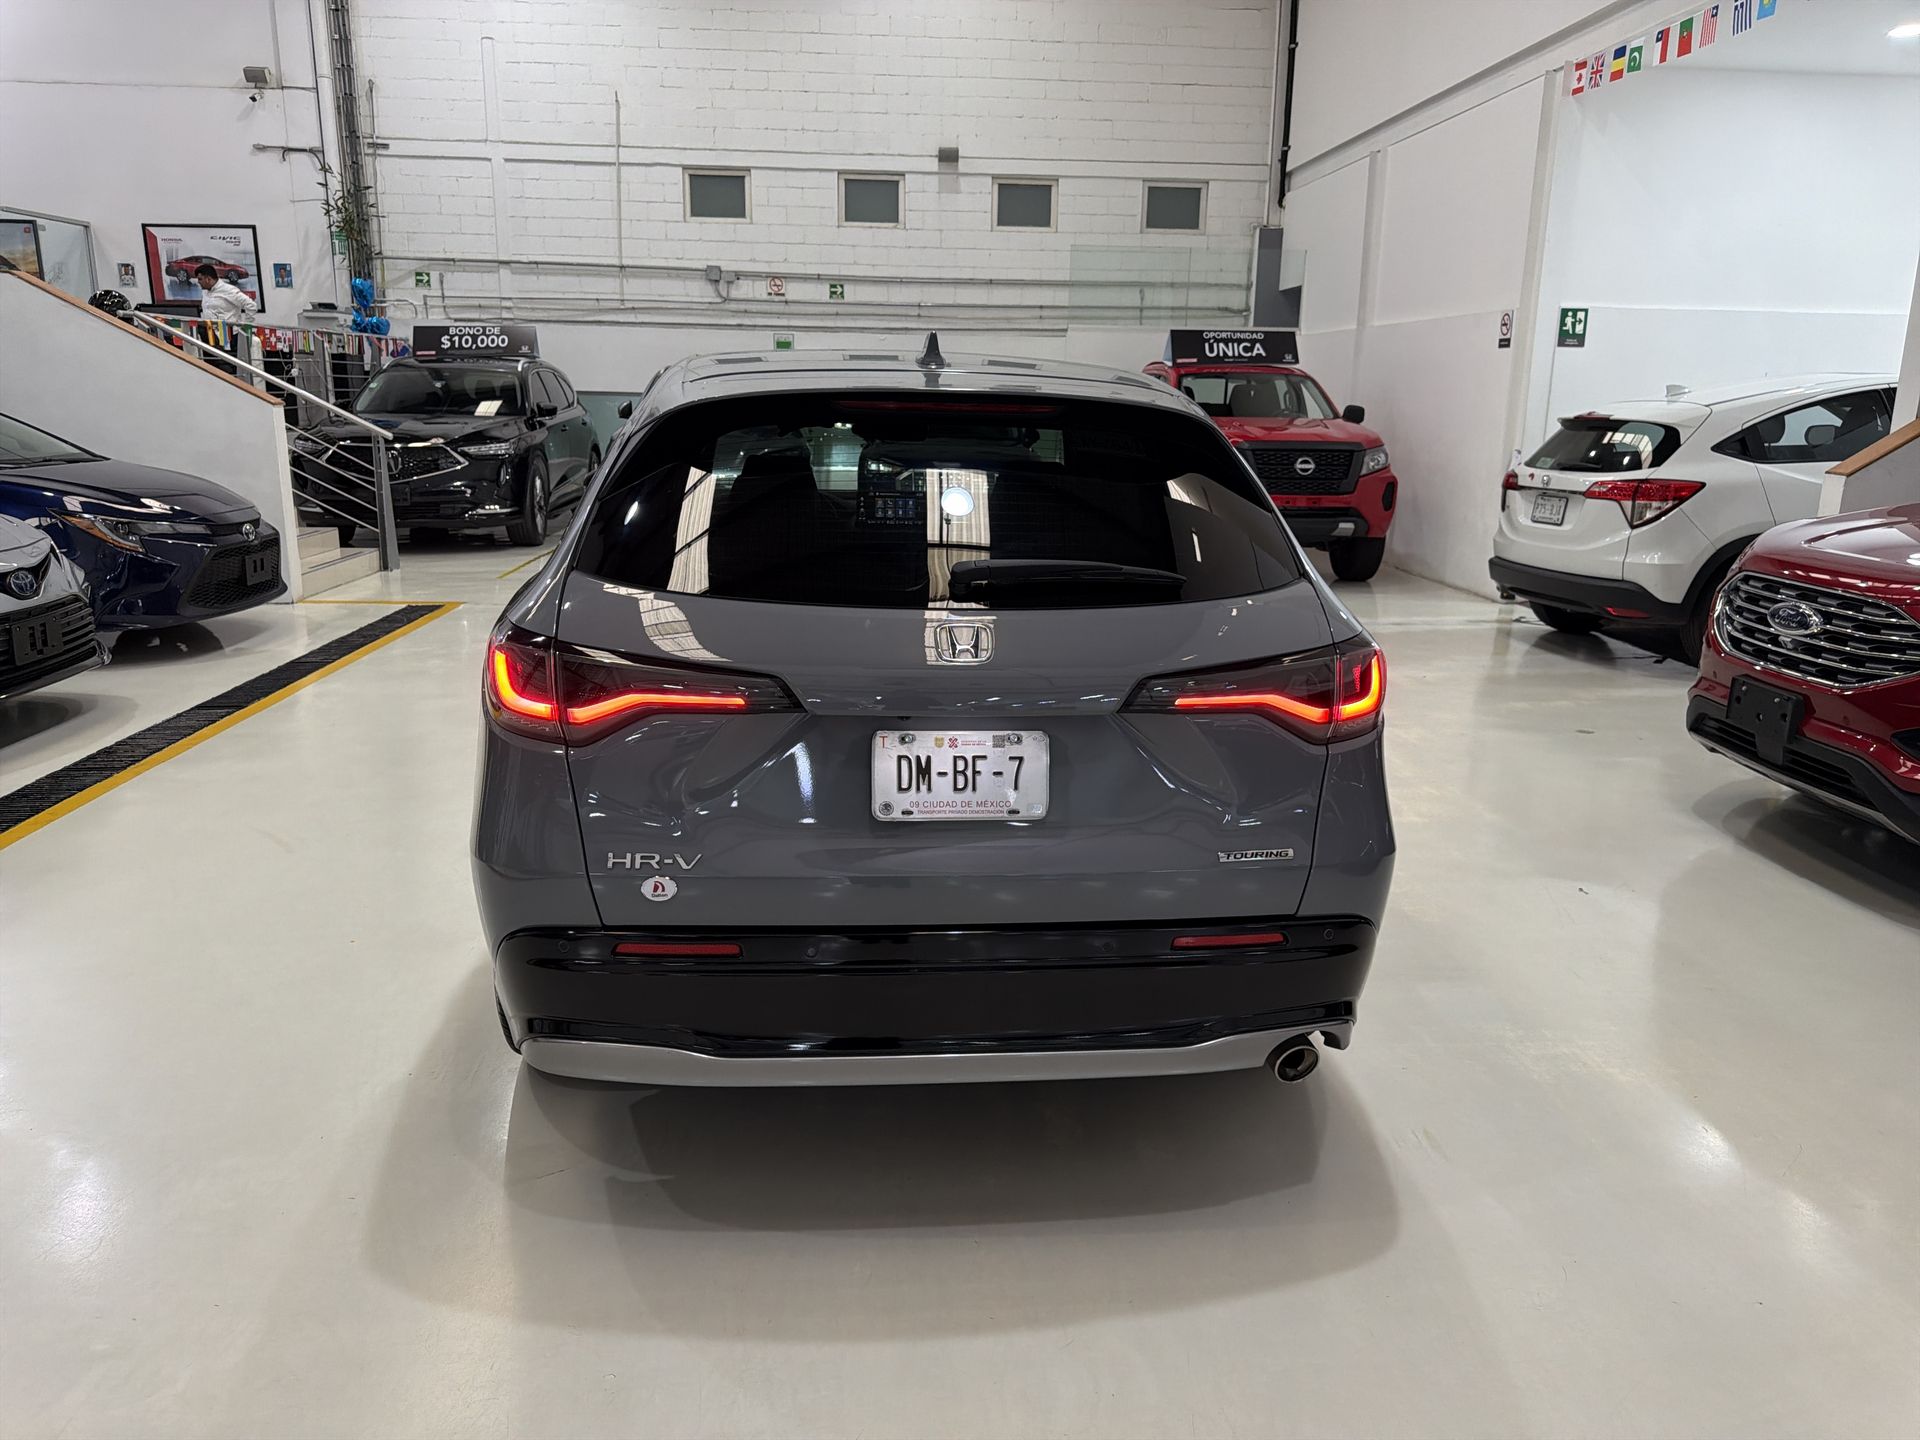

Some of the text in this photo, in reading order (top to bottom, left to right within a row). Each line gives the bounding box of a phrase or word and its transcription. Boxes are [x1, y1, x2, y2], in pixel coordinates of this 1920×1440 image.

[449, 326, 501, 335] BONO DE
[1203, 331, 1265, 340] OPORTUNIDAD
[440, 334, 509, 350] $10,000
[1204, 339, 1267, 357] ÚNICA
[879, 735, 888, 749] T
[897, 755, 1025, 793] DM-BF-7
[922, 801, 958, 809] CIUDAD
[960, 801, 973, 809] DE
[975, 799, 1012, 809] MÉXICO
[607, 852, 702, 870] HR-V
[1224, 849, 1290, 860] TOURING
